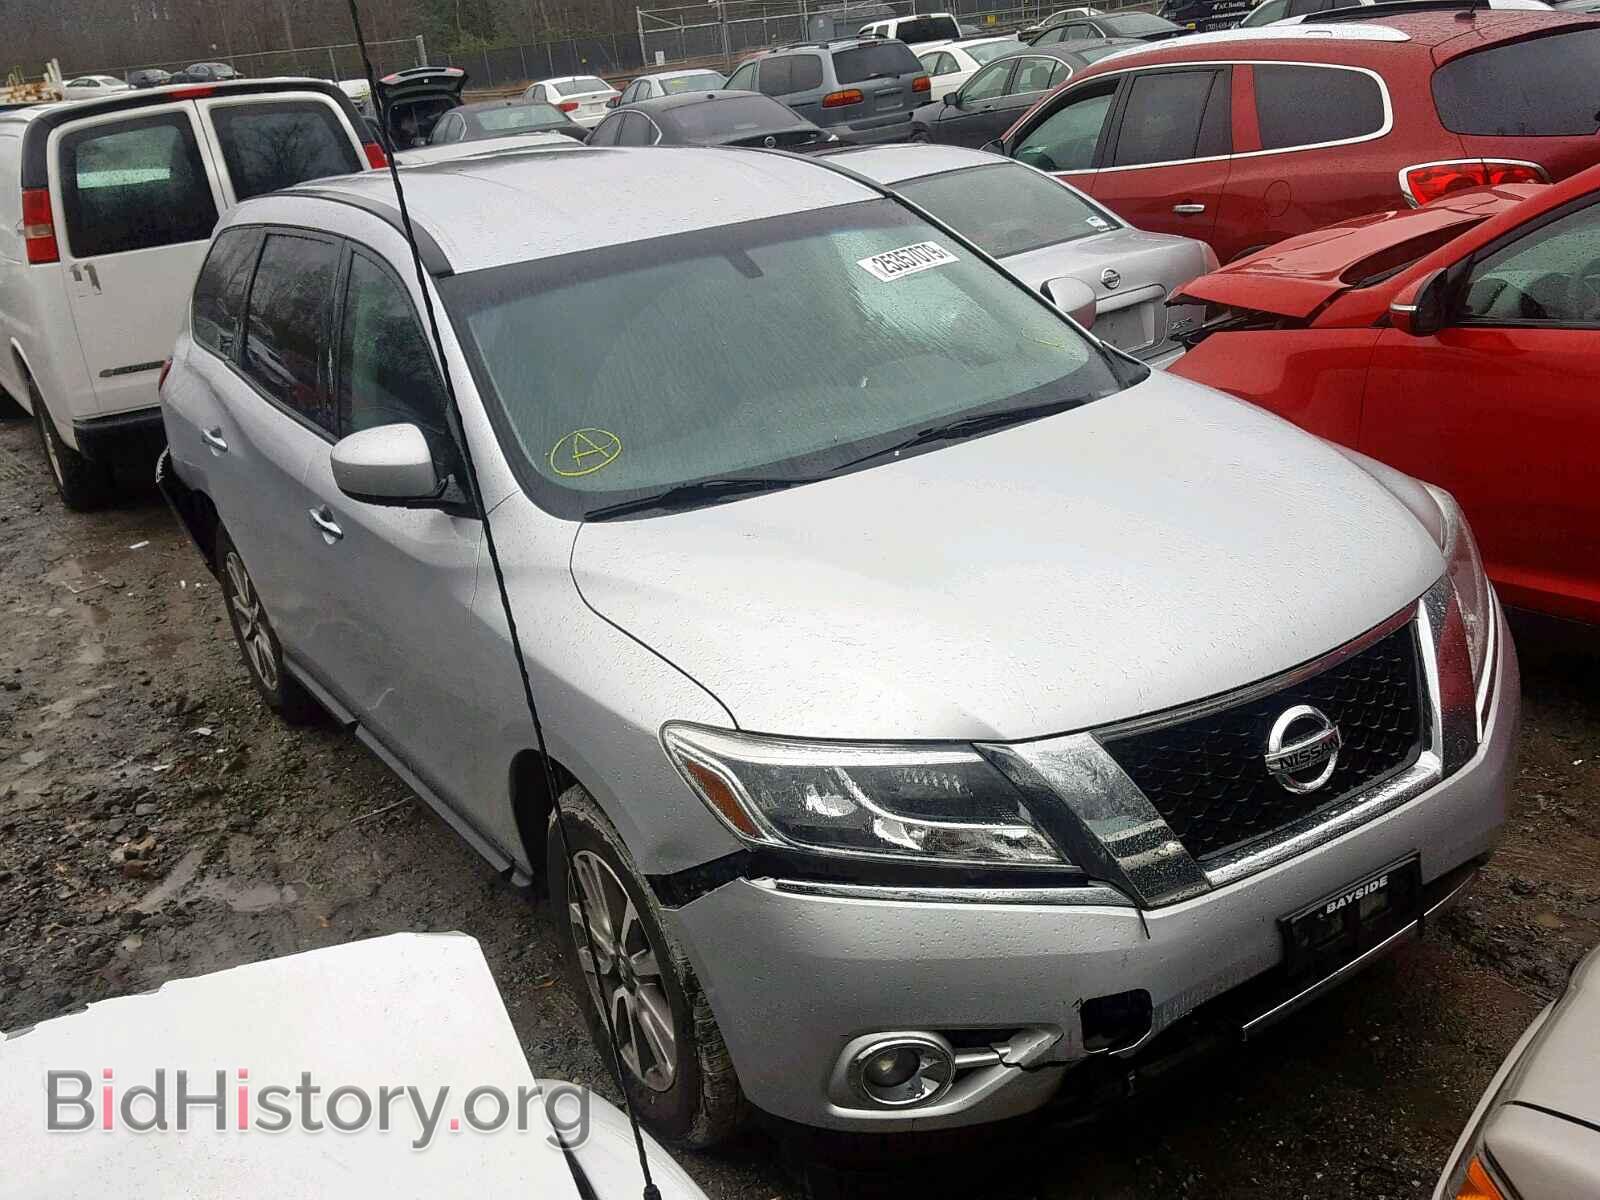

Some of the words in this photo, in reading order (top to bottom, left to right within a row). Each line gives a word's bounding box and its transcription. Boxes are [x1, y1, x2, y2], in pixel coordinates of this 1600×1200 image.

[872, 244, 945, 274] 25357079
[1280, 736, 1338, 769] NISSAN
[1326, 875, 1389, 914] BAYSIDE
